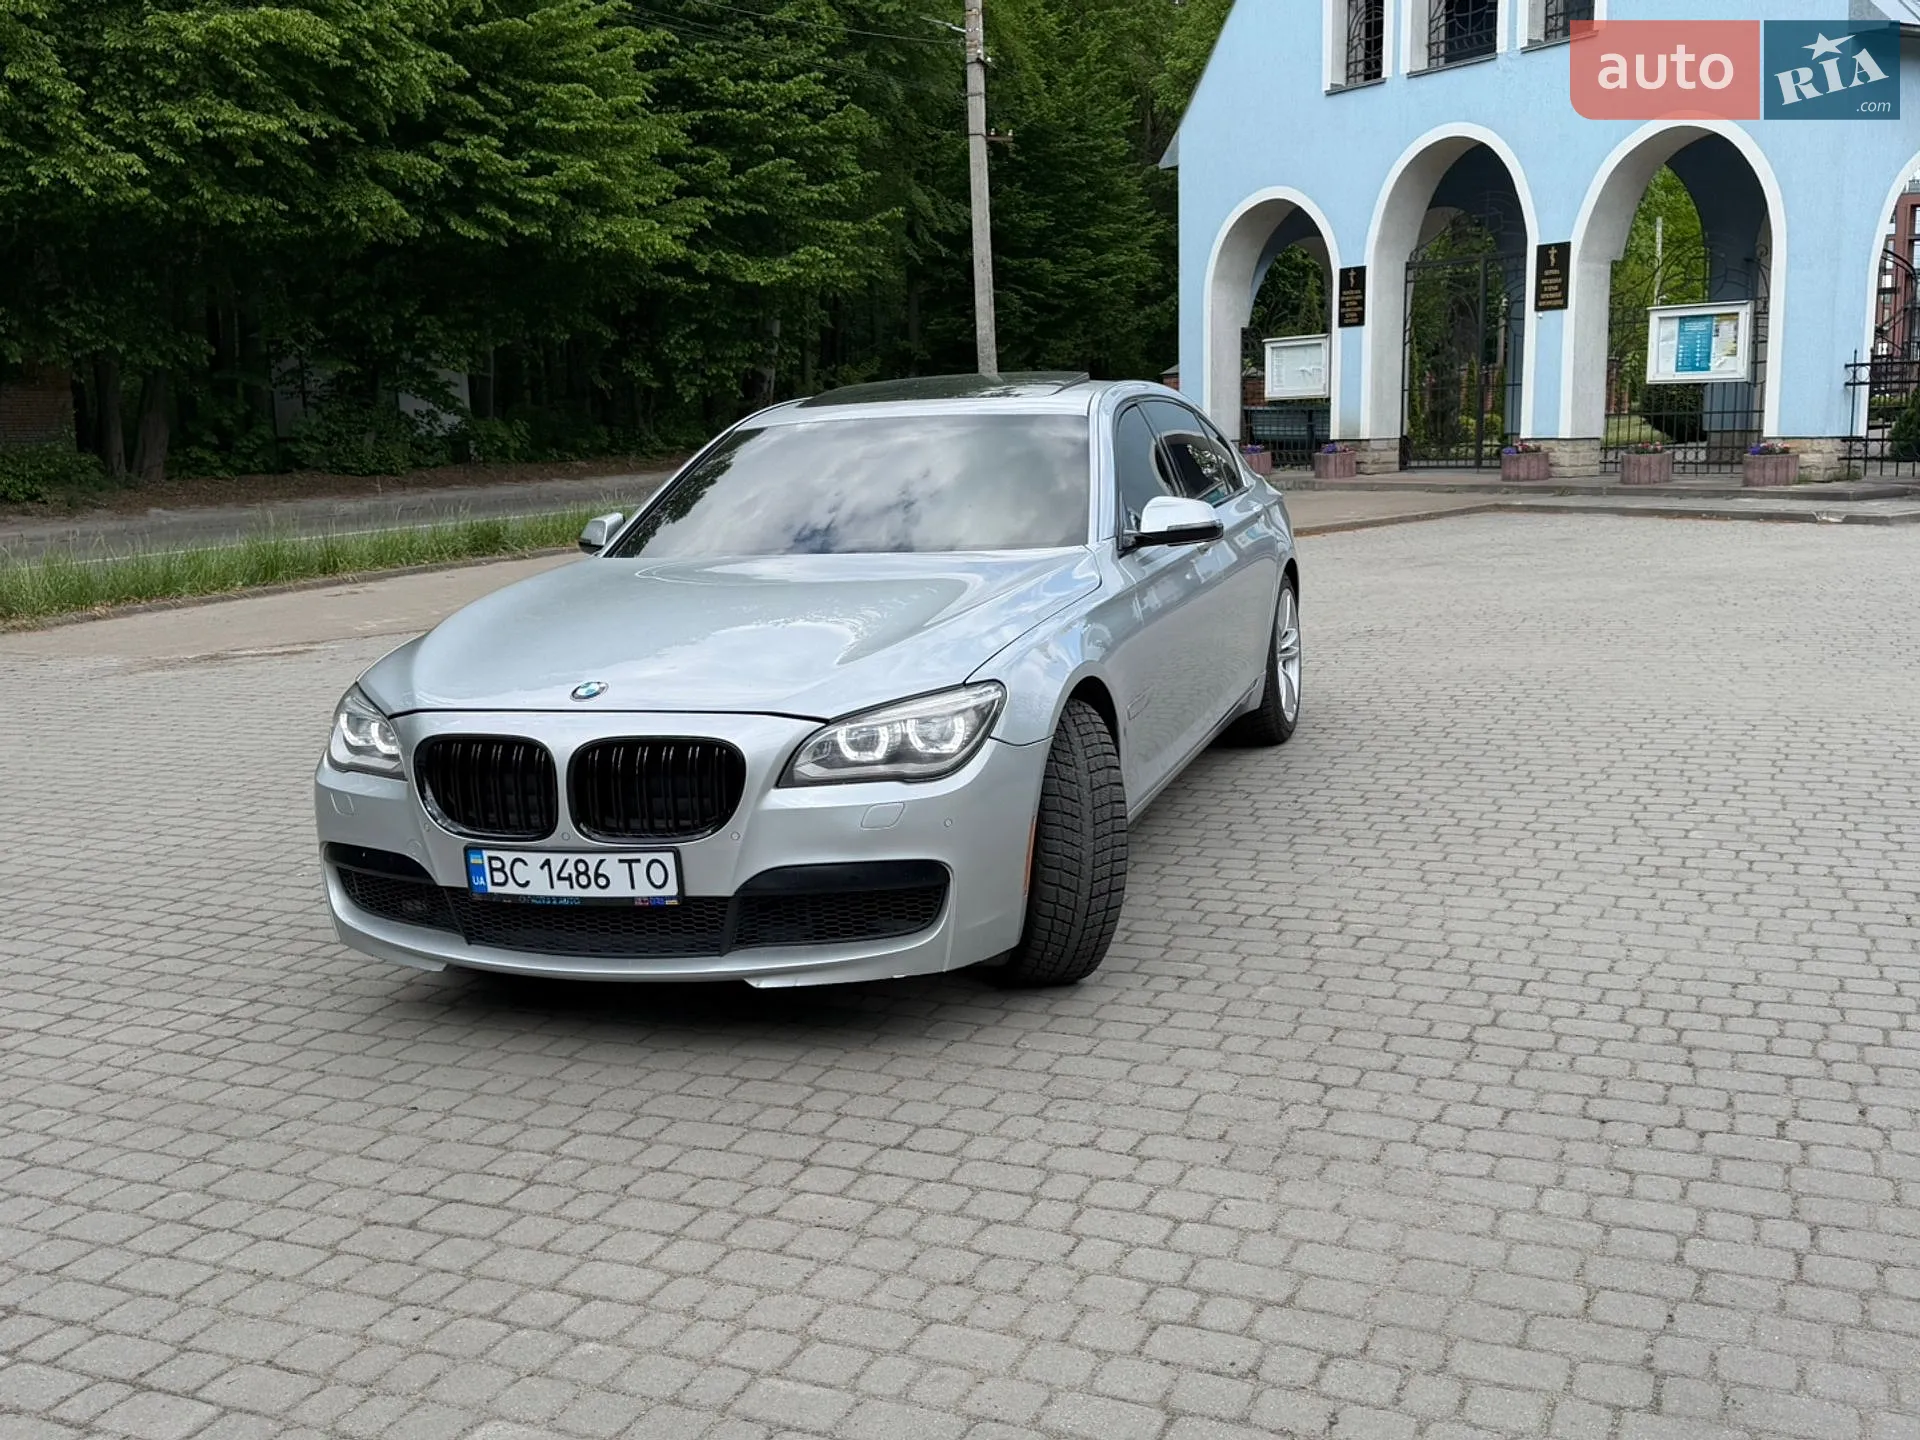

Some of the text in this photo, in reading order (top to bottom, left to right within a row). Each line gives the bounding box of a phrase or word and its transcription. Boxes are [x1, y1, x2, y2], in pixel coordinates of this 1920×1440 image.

[472, 875, 486, 887] UA
[487, 855, 670, 890] BC 1486 TO
